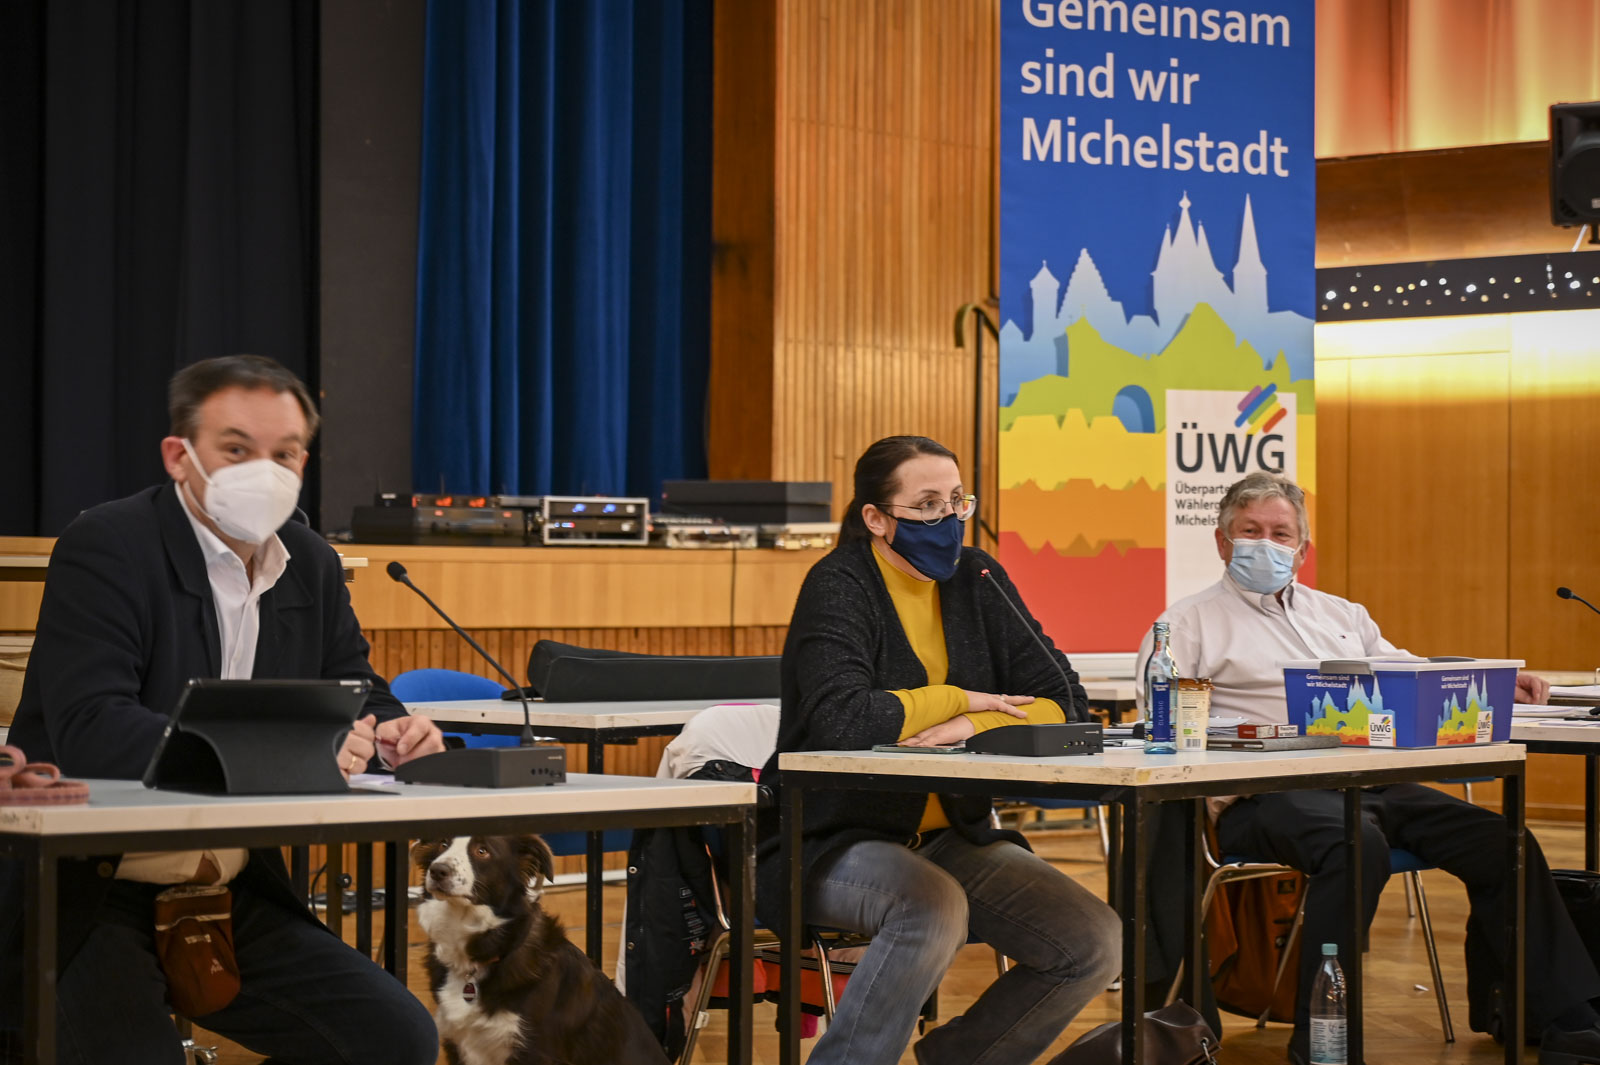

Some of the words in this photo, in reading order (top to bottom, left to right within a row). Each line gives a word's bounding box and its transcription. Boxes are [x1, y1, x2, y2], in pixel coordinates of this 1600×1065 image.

[1022, 0, 1290, 47] Gemeinsam
[1020, 48, 1114, 99] sind
[1128, 58, 1200, 105] wir
[1022, 116, 1289, 177] Michelstadt
[1176, 422, 1285, 474] ÜWG
[1175, 480, 1232, 497] Überparte
[1175, 514, 1218, 526] Michels
[1370, 722, 1391, 733] ÜWG
